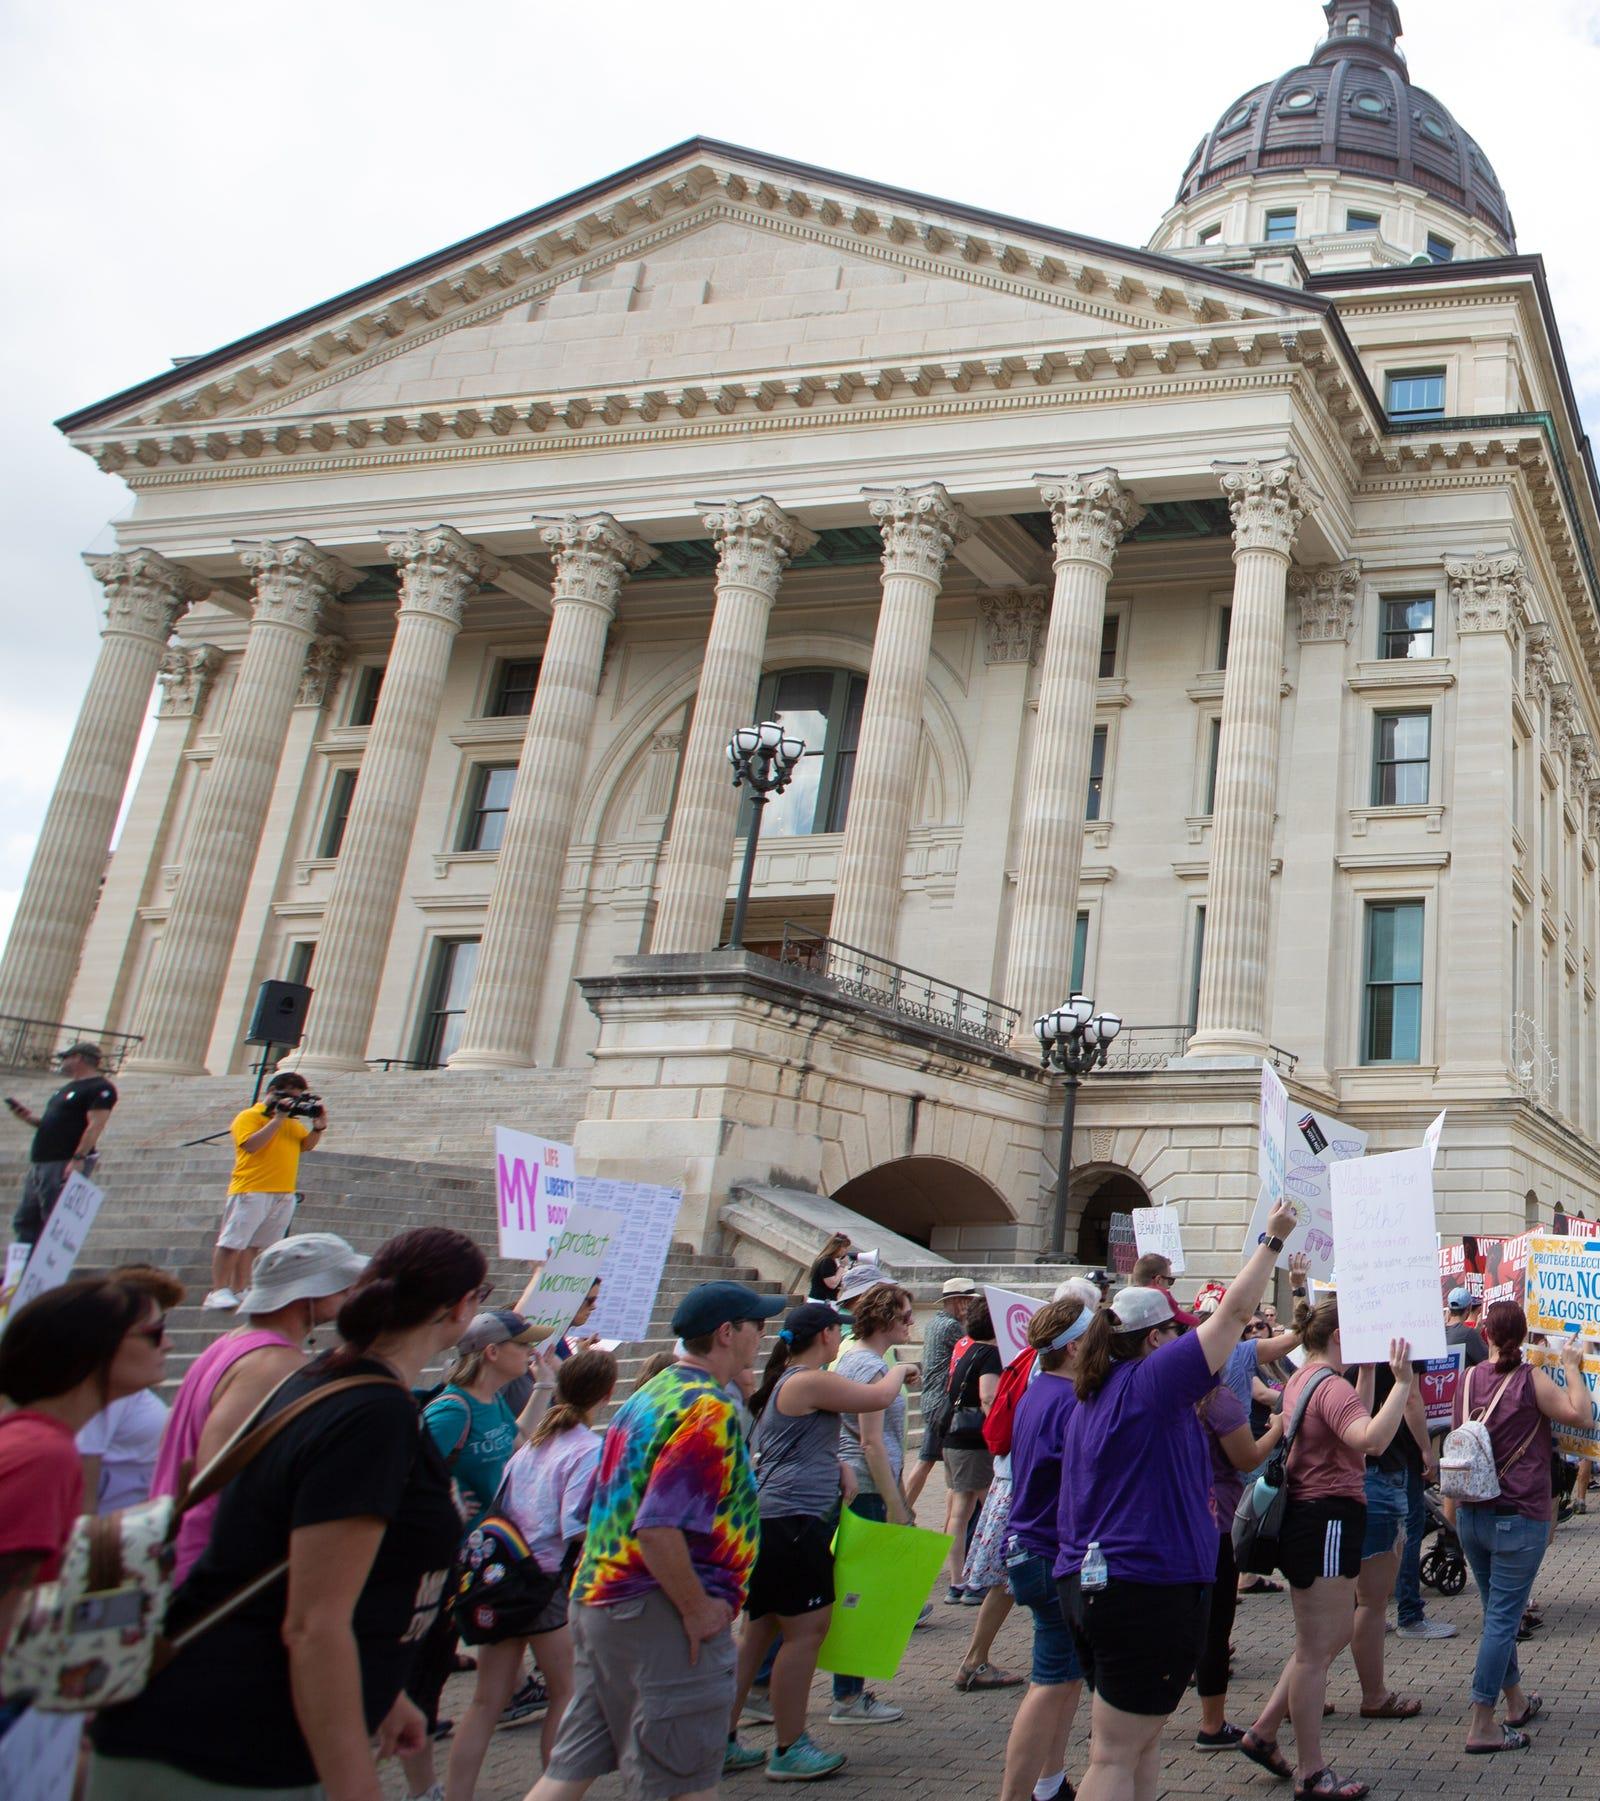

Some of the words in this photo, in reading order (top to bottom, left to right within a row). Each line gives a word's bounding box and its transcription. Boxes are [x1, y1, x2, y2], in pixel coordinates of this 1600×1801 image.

[544, 1146, 559, 1169] LIFE
[498, 1153, 539, 1232] MY
[544, 1176, 575, 1200] LIBERTY
[1568, 1218, 1594, 1238] VOTE
[555, 1231, 610, 1259] protect
[1439, 1247, 1450, 1268] TE
[1452, 1244, 1465, 1265] NO
[1503, 1236, 1528, 1263] VOTE
[1533, 1252, 1570, 1267] PROTEGE
[1465, 1282, 1484, 1298] LIBE
[1538, 1270, 1575, 1293] VOTA
[1538, 1298, 1547, 1316] 2
